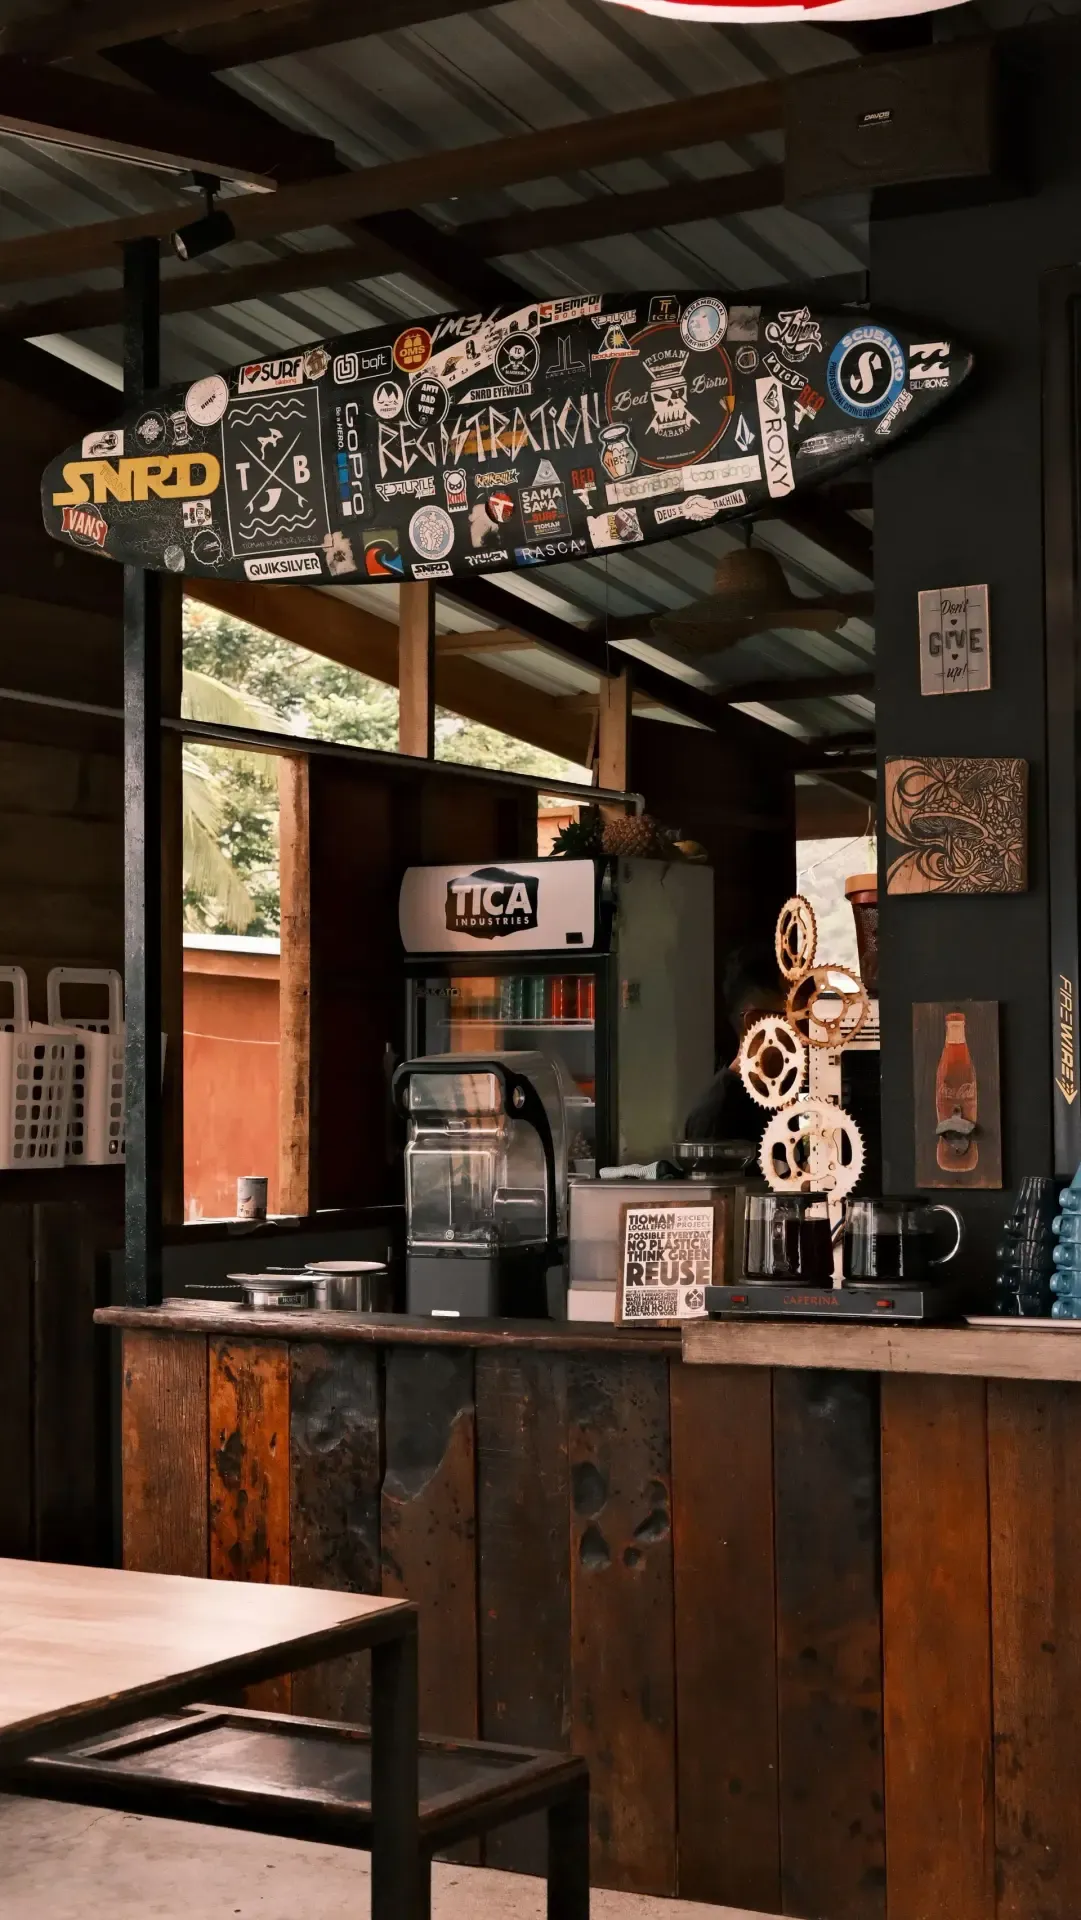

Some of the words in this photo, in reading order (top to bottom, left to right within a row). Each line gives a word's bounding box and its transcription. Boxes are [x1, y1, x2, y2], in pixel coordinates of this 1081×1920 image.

[554, 305, 600, 320] BOOGIE
[684, 333, 709, 347] SURFING
[400, 345, 425, 357] OMS
[645, 349, 686, 366] TIOMAN
[842, 328, 904, 381] SCUBAPRO
[767, 355, 805, 387] VOLCOM
[421, 383, 439, 394] ANTI
[690, 374, 728, 393] Bistro
[420, 394, 435, 405] BAD
[470, 388, 491, 400] SNRD
[493, 384, 529, 398] EYEWEAR
[612, 389, 649, 411] Bed
[657, 425, 691, 437] CABANA
[765, 419, 790, 488] ROXY
[53, 452, 221, 506] SNRD
[235, 462, 250, 491] T
[293, 455, 311, 484] B
[522, 487, 563, 503] SAMA
[524, 499, 558, 514] SAMA
[656, 509, 677, 521] DEUS
[713, 493, 744, 508] MACHINA
[67, 510, 103, 540] VANS
[249, 558, 320, 576] QUIKSILVER
[414, 563, 449, 573] SNRD
[941, 599, 969, 615] Don't
[929, 628, 984, 657] GIVE
[947, 663, 967, 682] up!
[452, 883, 533, 916] TICA
[455, 916, 530, 926] INDUSTRIES
[1059, 974, 1074, 1082] FIREWIRE
[629, 1213, 676, 1225] TIOMAN
[628, 1232, 665, 1240] POSSIBLE
[667, 1231, 711, 1239] EVERYDAY
[627, 1240, 646, 1251] NO
[650, 1239, 699, 1250] PLASTIC
[627, 1250, 665, 1262] THINK
[668, 1249, 710, 1261] GREEN
[626, 1261, 710, 1286] REUSE
[652, 1304, 677, 1312] HOUSE
[783, 1295, 840, 1306] CAFERINA
